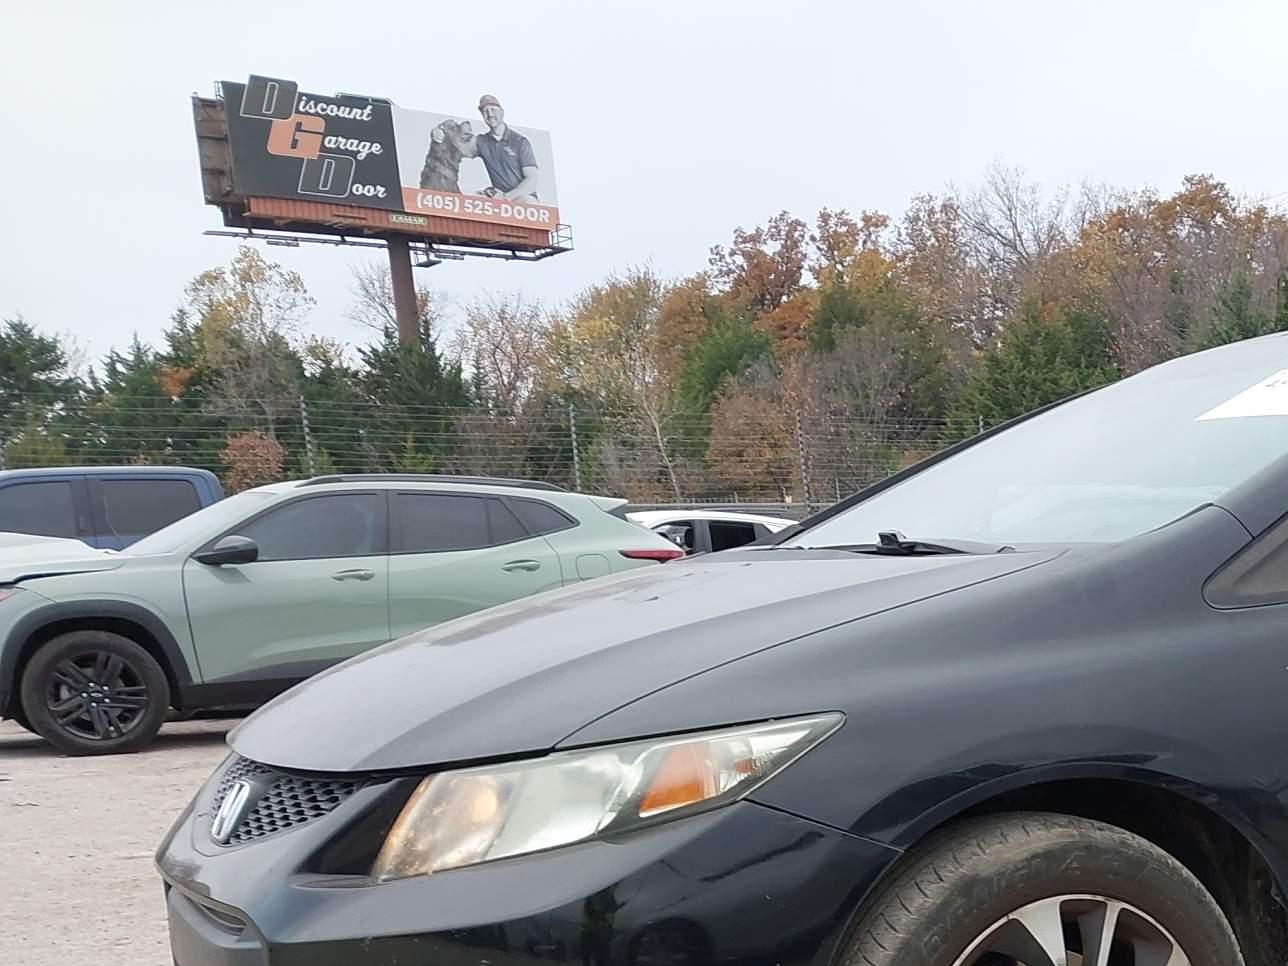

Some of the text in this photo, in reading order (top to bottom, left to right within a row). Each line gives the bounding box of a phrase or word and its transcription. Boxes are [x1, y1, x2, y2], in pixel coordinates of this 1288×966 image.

[240, 74, 374, 121] Discount
[267, 113, 384, 160] Garage
[297, 152, 388, 198] Door
[416, 191, 551, 224] (405) 525-DOOR
